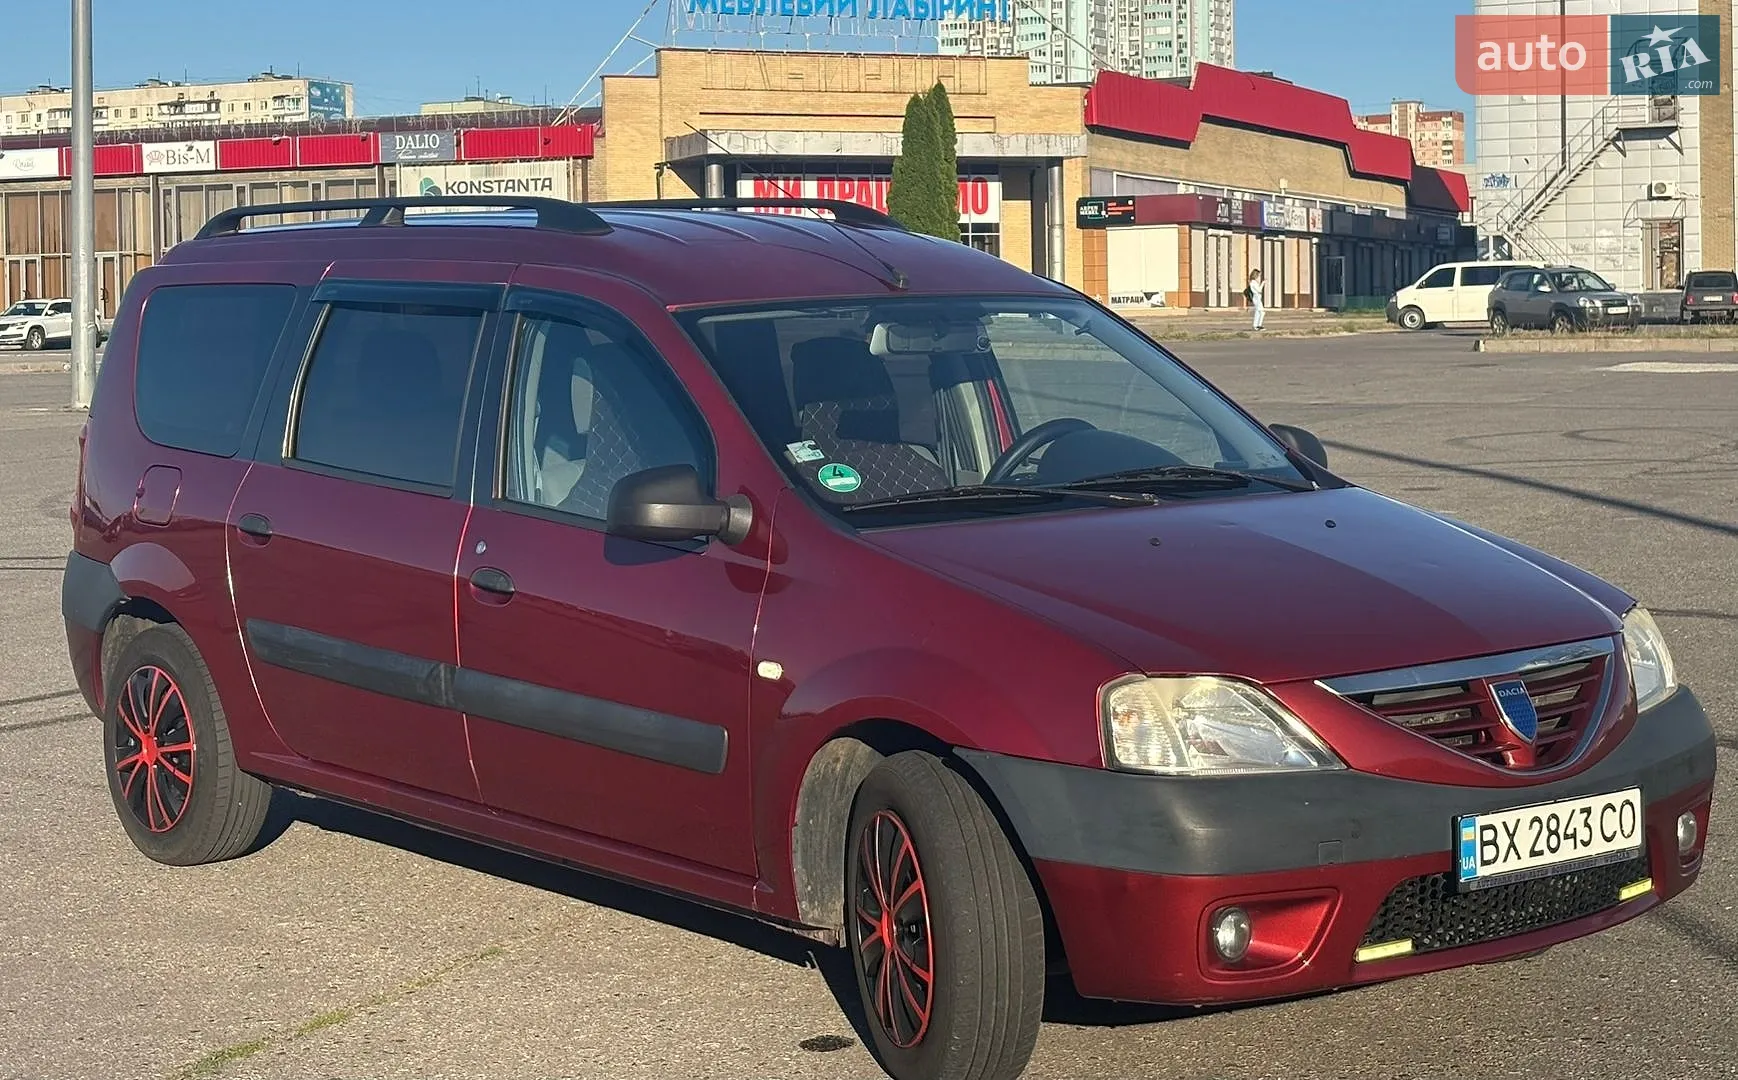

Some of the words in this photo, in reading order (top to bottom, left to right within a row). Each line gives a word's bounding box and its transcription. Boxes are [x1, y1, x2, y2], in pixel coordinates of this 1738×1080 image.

[395, 133, 440, 150] DALIO
[166, 147, 210, 165] Bis-M
[445, 177, 552, 195] KONSTANTA
[1111, 296, 1145, 305] МАТРАЦИ
[832, 465, 845, 478] 4
[1498, 687, 1526, 698] DACIA
[1479, 817, 1522, 868] BX
[1528, 805, 1593, 859] 2843
[1600, 798, 1636, 844] CO
[1461, 855, 1476, 871] UA
